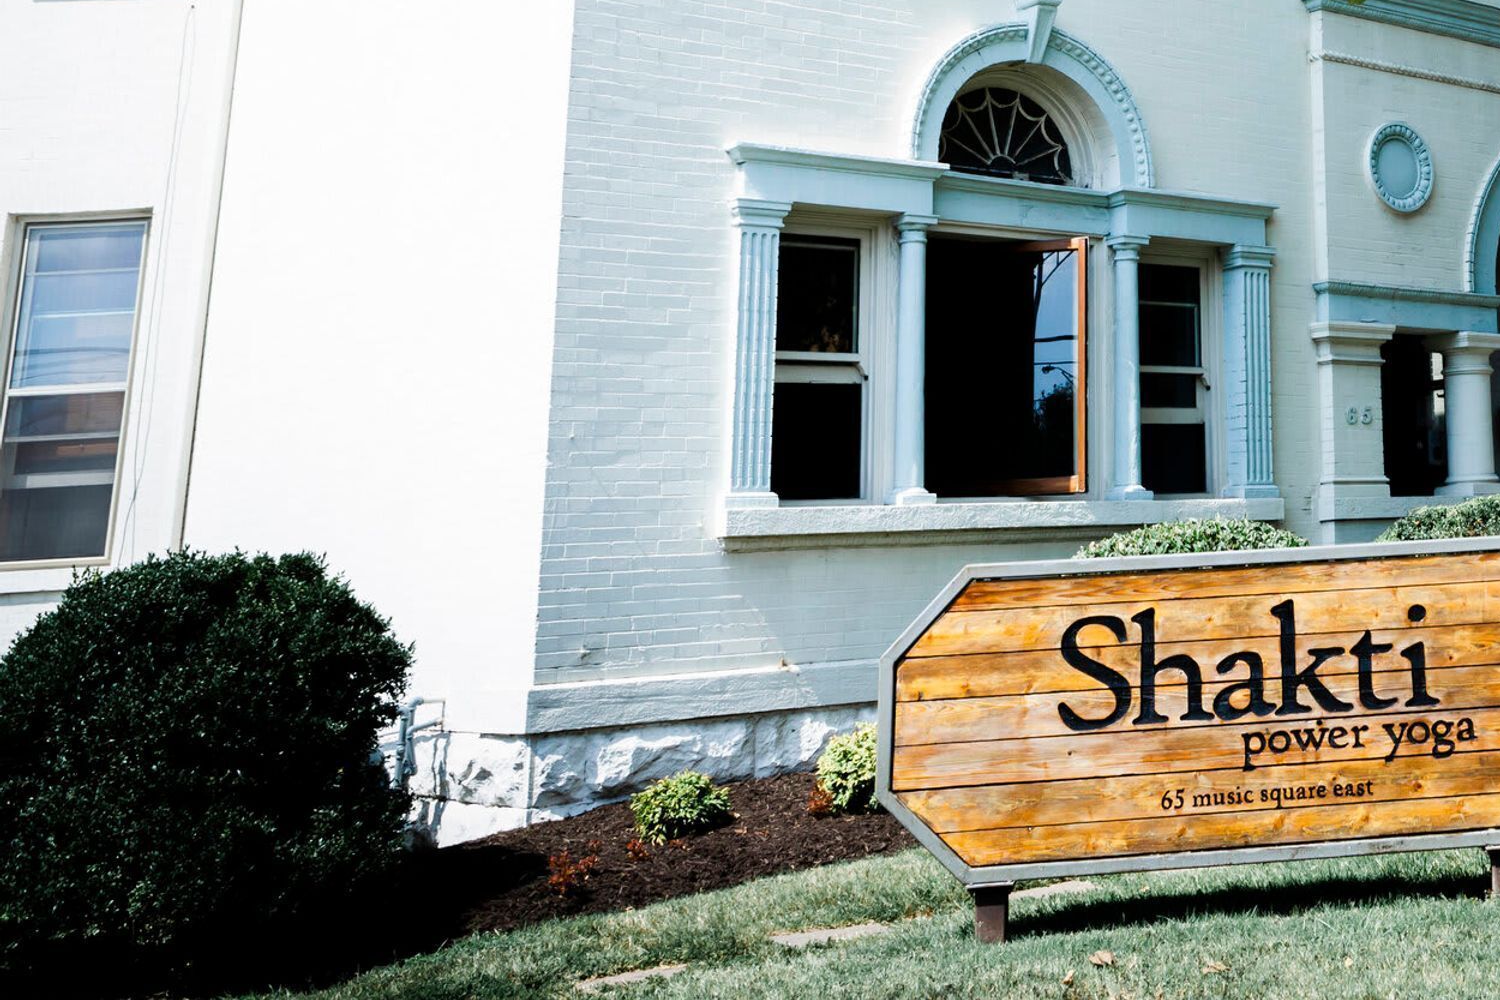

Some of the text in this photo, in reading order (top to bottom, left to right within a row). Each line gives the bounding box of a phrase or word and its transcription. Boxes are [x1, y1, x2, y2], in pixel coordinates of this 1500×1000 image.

[1344, 406, 1374, 427] 65
[1058, 599, 1440, 731] Shakti
[1242, 717, 1478, 771] power yoga
[1161, 779, 1374, 810] 65 music square east
